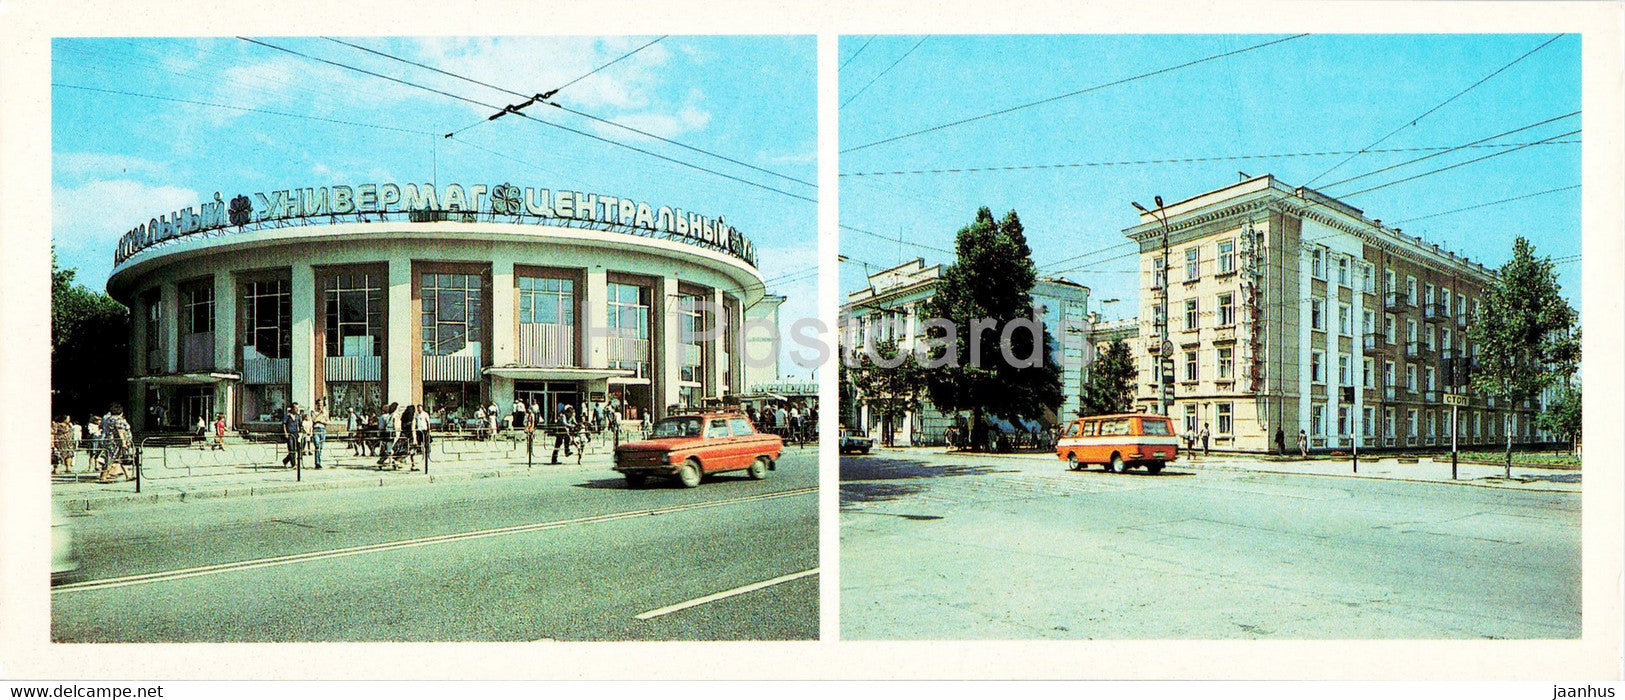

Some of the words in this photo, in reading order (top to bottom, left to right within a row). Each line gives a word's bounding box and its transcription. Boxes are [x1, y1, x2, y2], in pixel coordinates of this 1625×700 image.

[255, 182, 488, 218] УНИВЕРМАГ
[524, 186, 730, 250] ЦЕНТРАЛЬНЫЙ
[1446, 395, 1467, 405] СТОП
